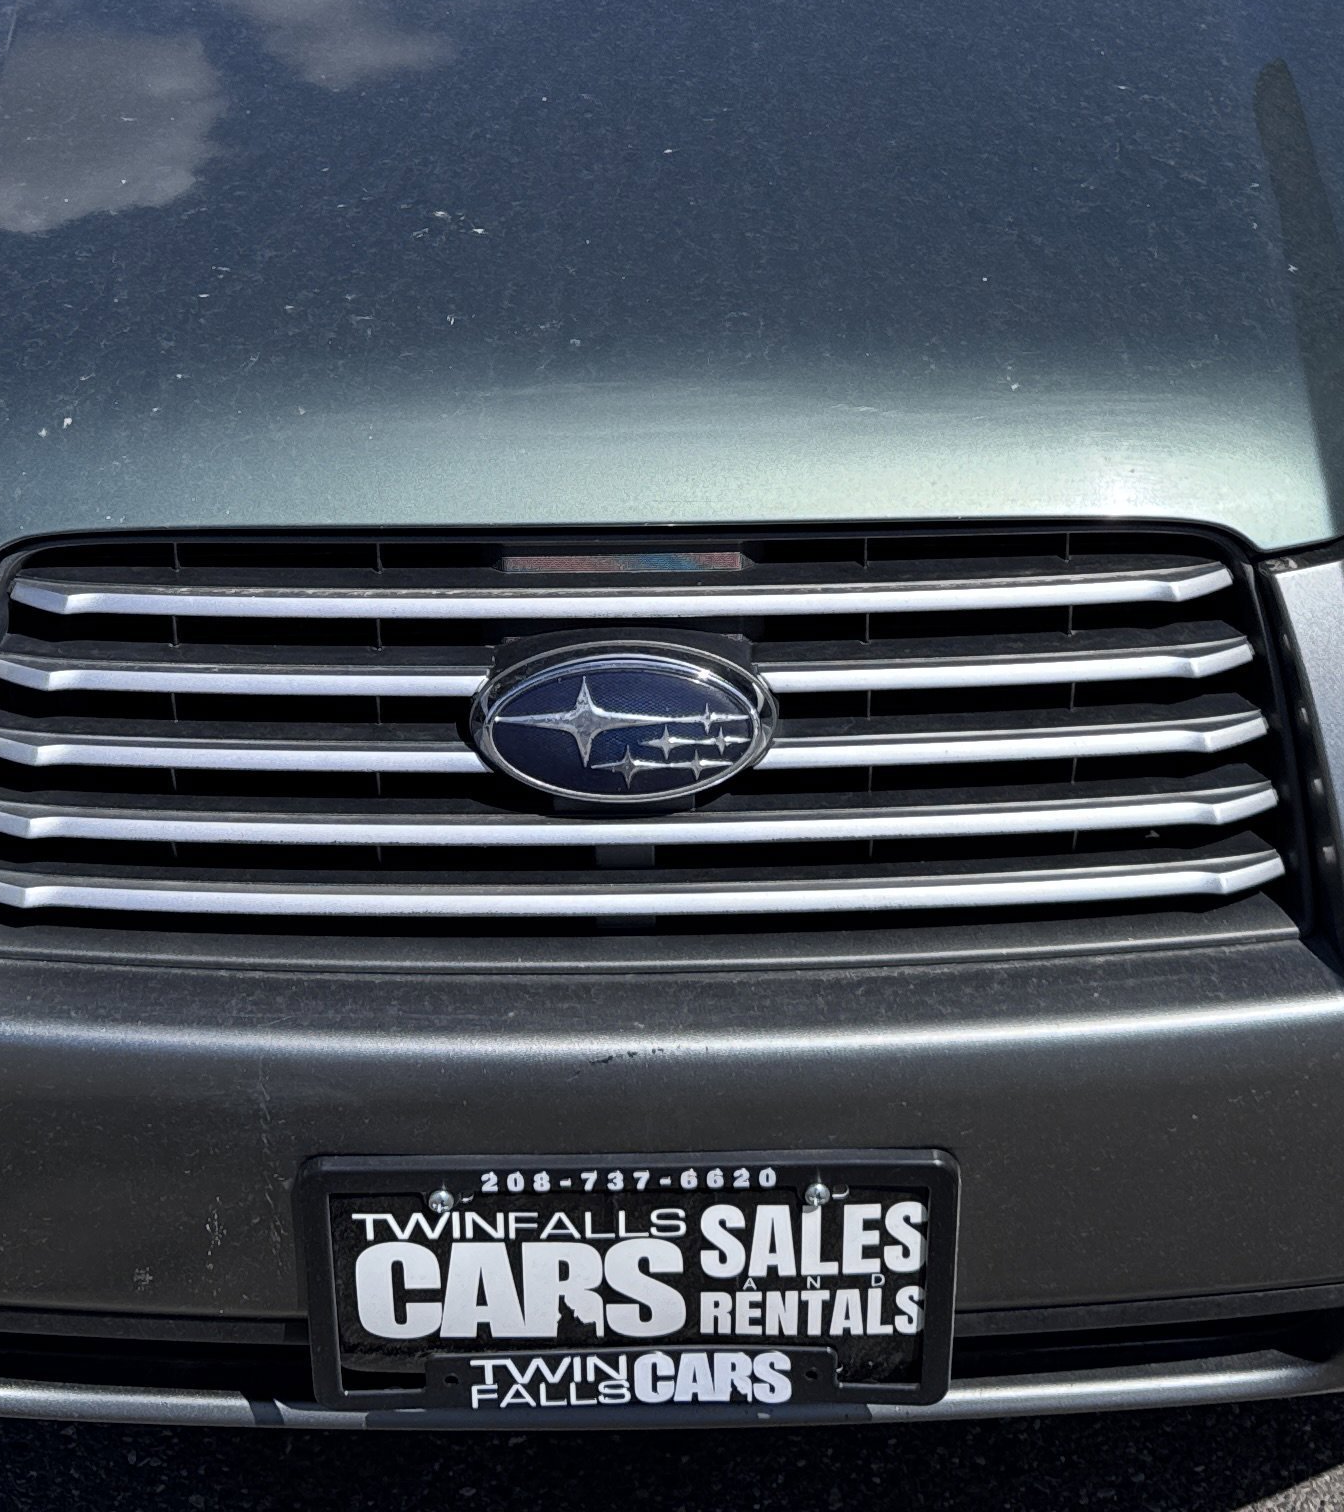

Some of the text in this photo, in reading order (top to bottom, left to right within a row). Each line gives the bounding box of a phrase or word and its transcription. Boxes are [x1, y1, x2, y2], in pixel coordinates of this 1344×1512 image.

[481, 1166, 777, 1193] 208-737-6620
[700, 1201, 929, 1279] SALES
[356, 1238, 687, 1339] CARS
[700, 1285, 925, 1336] RENTALS
[469, 1351, 793, 1404] TWIN CARS
[471, 1380, 631, 1409] FALLS
